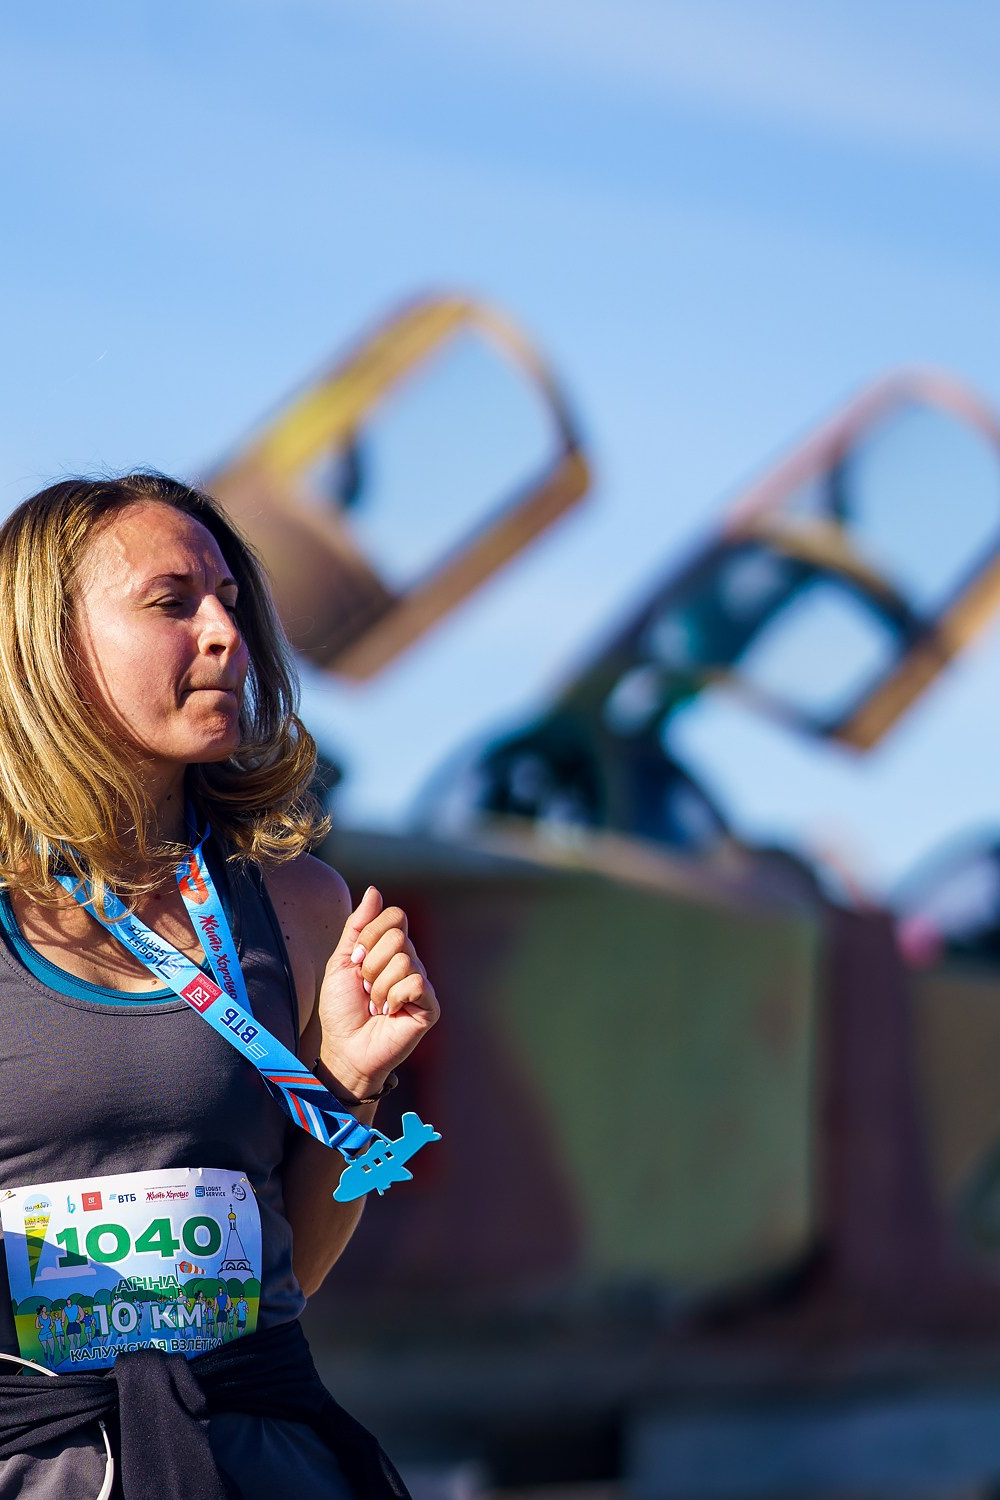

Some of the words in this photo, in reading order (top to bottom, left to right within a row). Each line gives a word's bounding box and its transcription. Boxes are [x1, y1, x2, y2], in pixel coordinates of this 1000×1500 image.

[127, 936, 160, 967] LOGIST
[128, 924, 167, 958] SERVICE
[198, 914, 222, 952] Жить
[214, 953, 238, 999] Хорошо
[219, 1007, 259, 1045] ВТБ
[117, 1193, 137, 1203] ВТБ
[145, 1190, 165, 1201] Жить
[55, 1215, 222, 1268] 1040
[116, 1274, 180, 1292] АННА
[93, 1301, 139, 1336] 10
[150, 1303, 203, 1330] КМ
[170, 1336, 224, 1351] ВЗЛЁТКА
